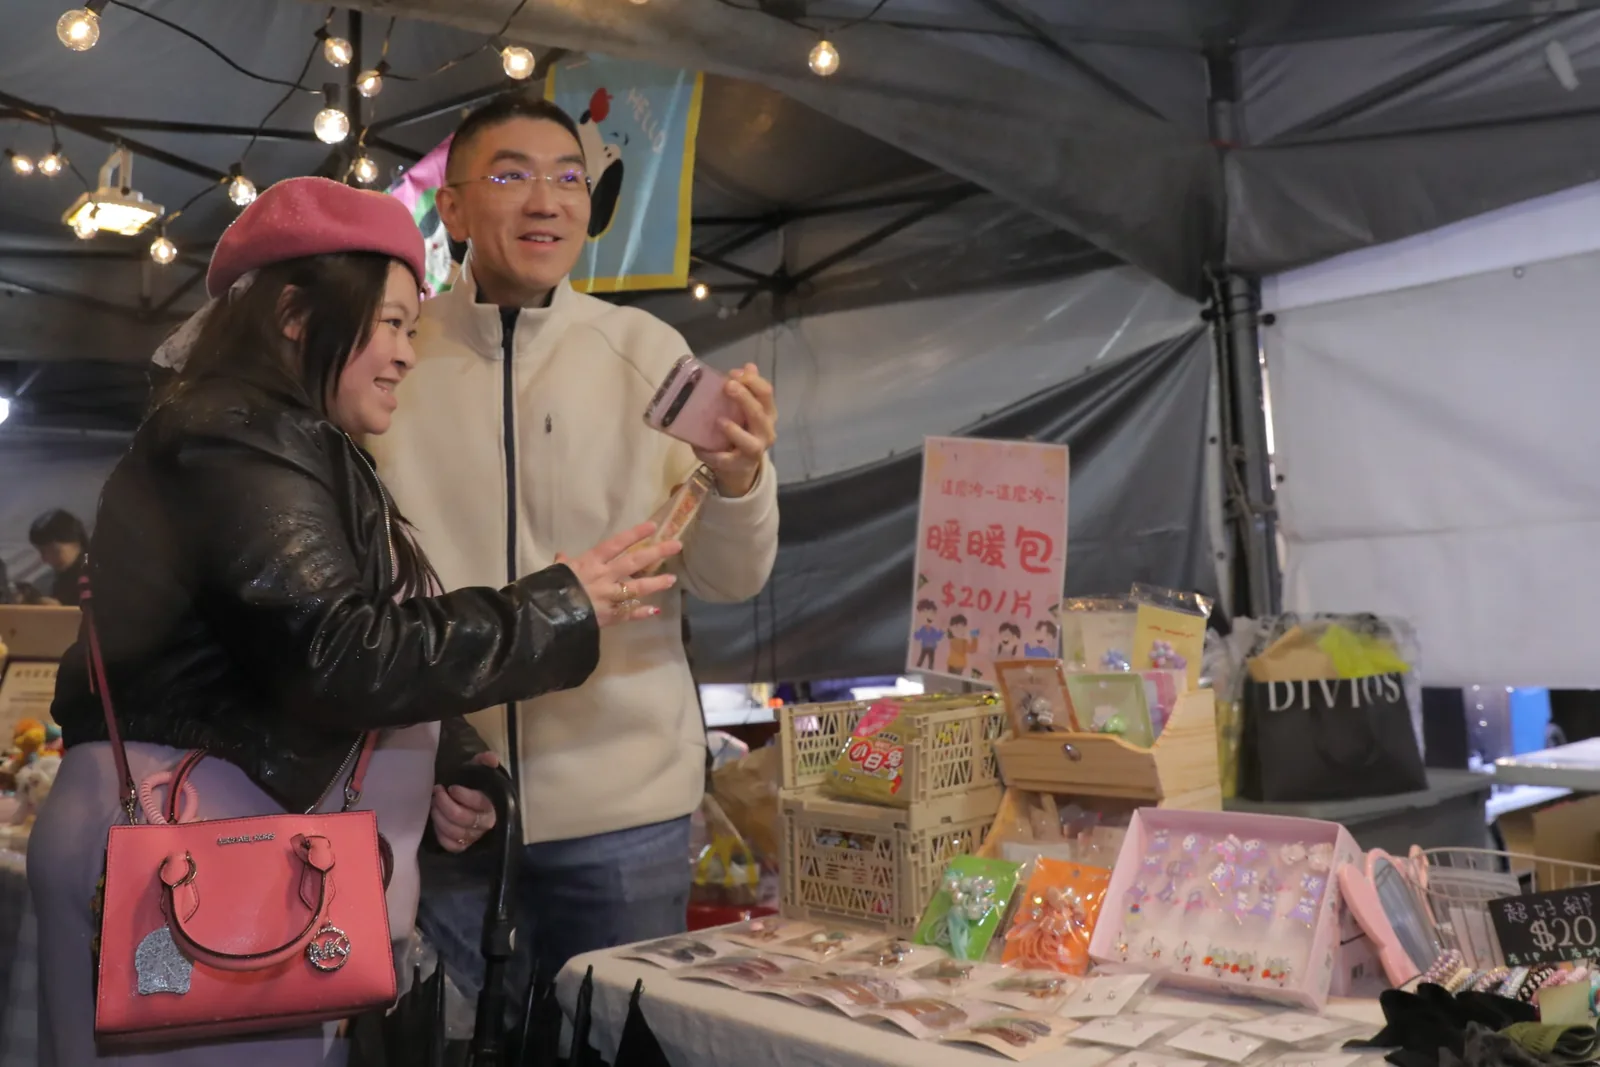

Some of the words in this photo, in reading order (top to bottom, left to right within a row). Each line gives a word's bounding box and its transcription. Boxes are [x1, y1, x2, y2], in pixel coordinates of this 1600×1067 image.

[926, 519, 1054, 574] 暖暖包
[1529, 915, 1597, 951] $20
